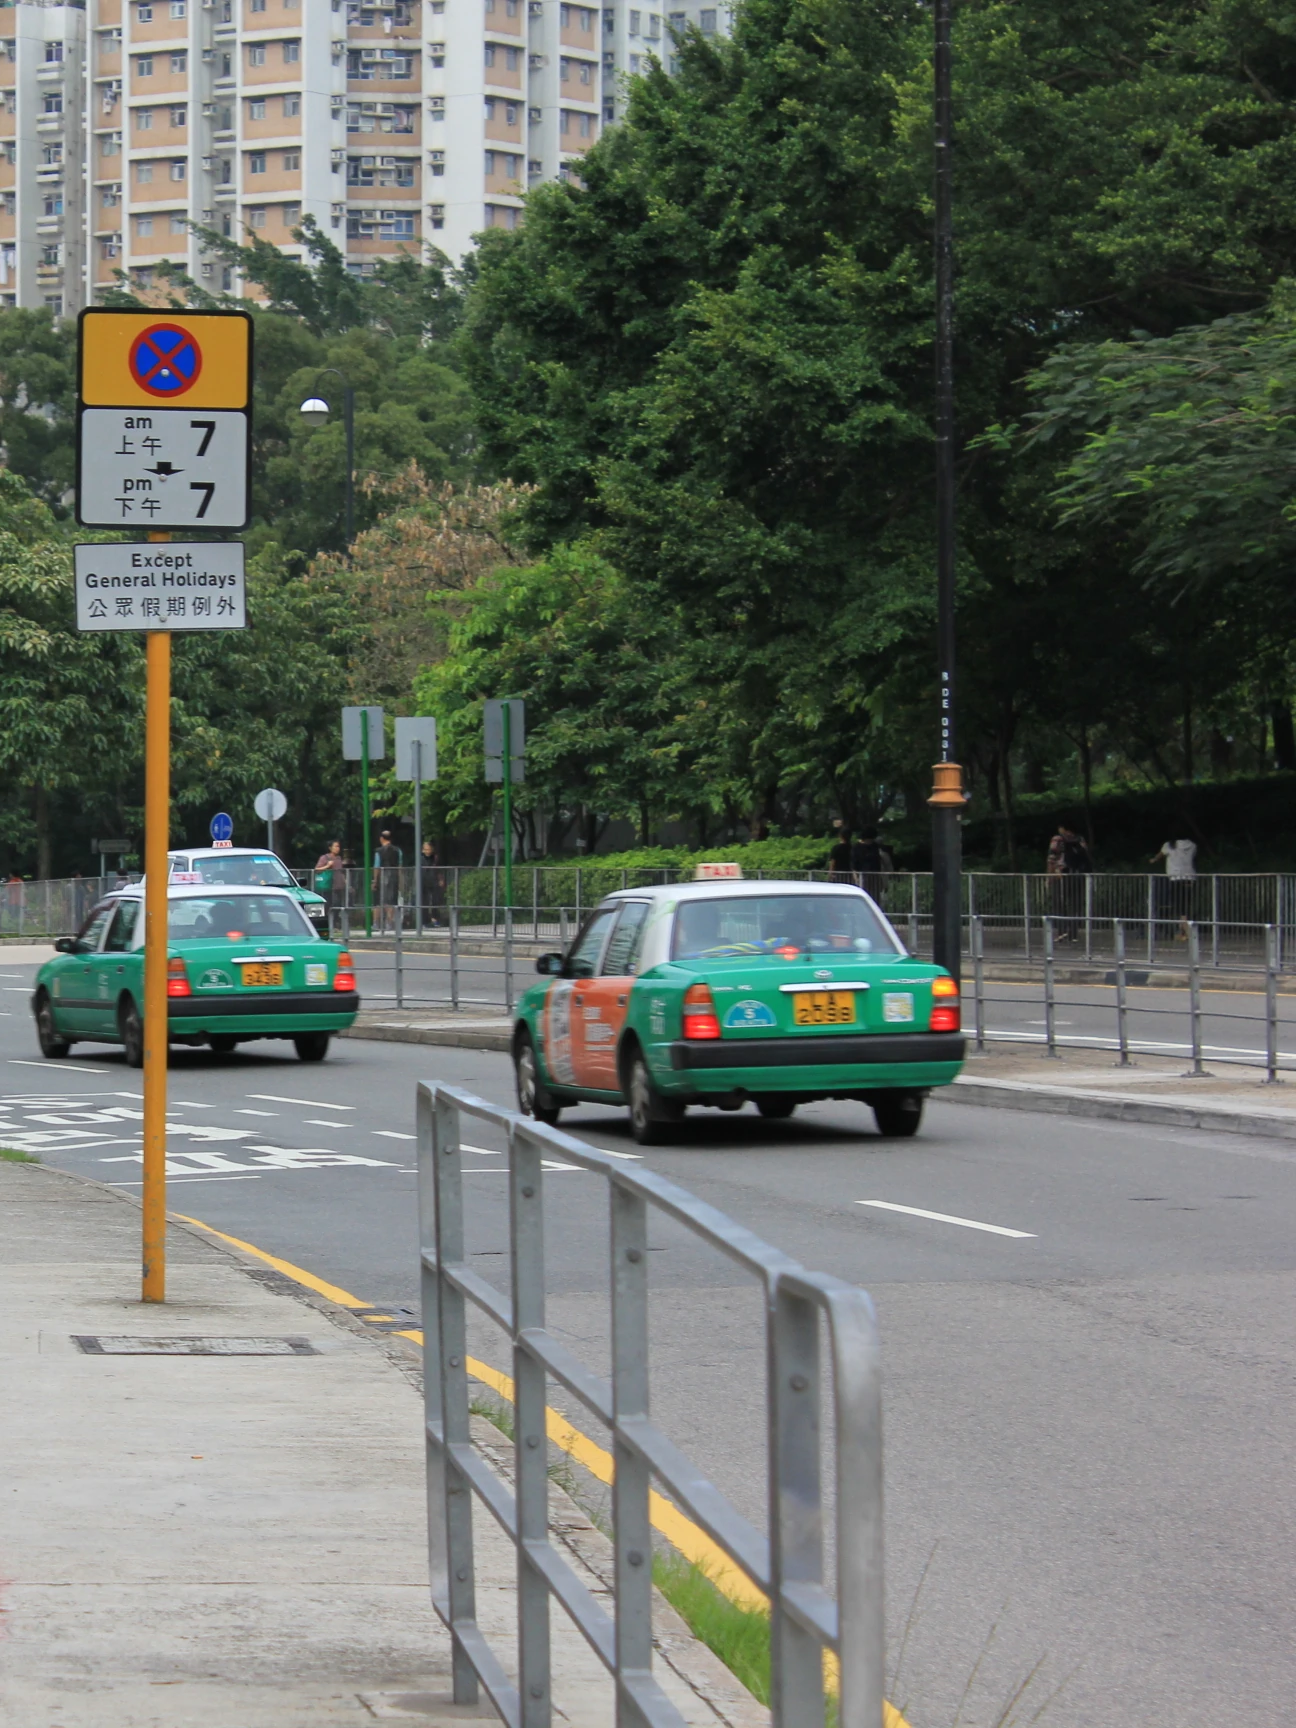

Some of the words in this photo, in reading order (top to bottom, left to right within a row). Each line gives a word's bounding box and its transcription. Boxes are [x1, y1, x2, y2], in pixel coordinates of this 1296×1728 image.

[115, 435, 162, 456] 上午
[124, 416, 152, 429] am
[190, 420, 216, 456] 7
[124, 477, 152, 494] pm
[190, 482, 215, 518] 7
[114, 498, 162, 518] 下午
[132, 553, 192, 570] Except
[86, 574, 156, 588] General
[162, 572, 236, 590] Holidays
[88, 596, 236, 618] 公眾假期例外
[702, 866, 738, 877] TAXI
